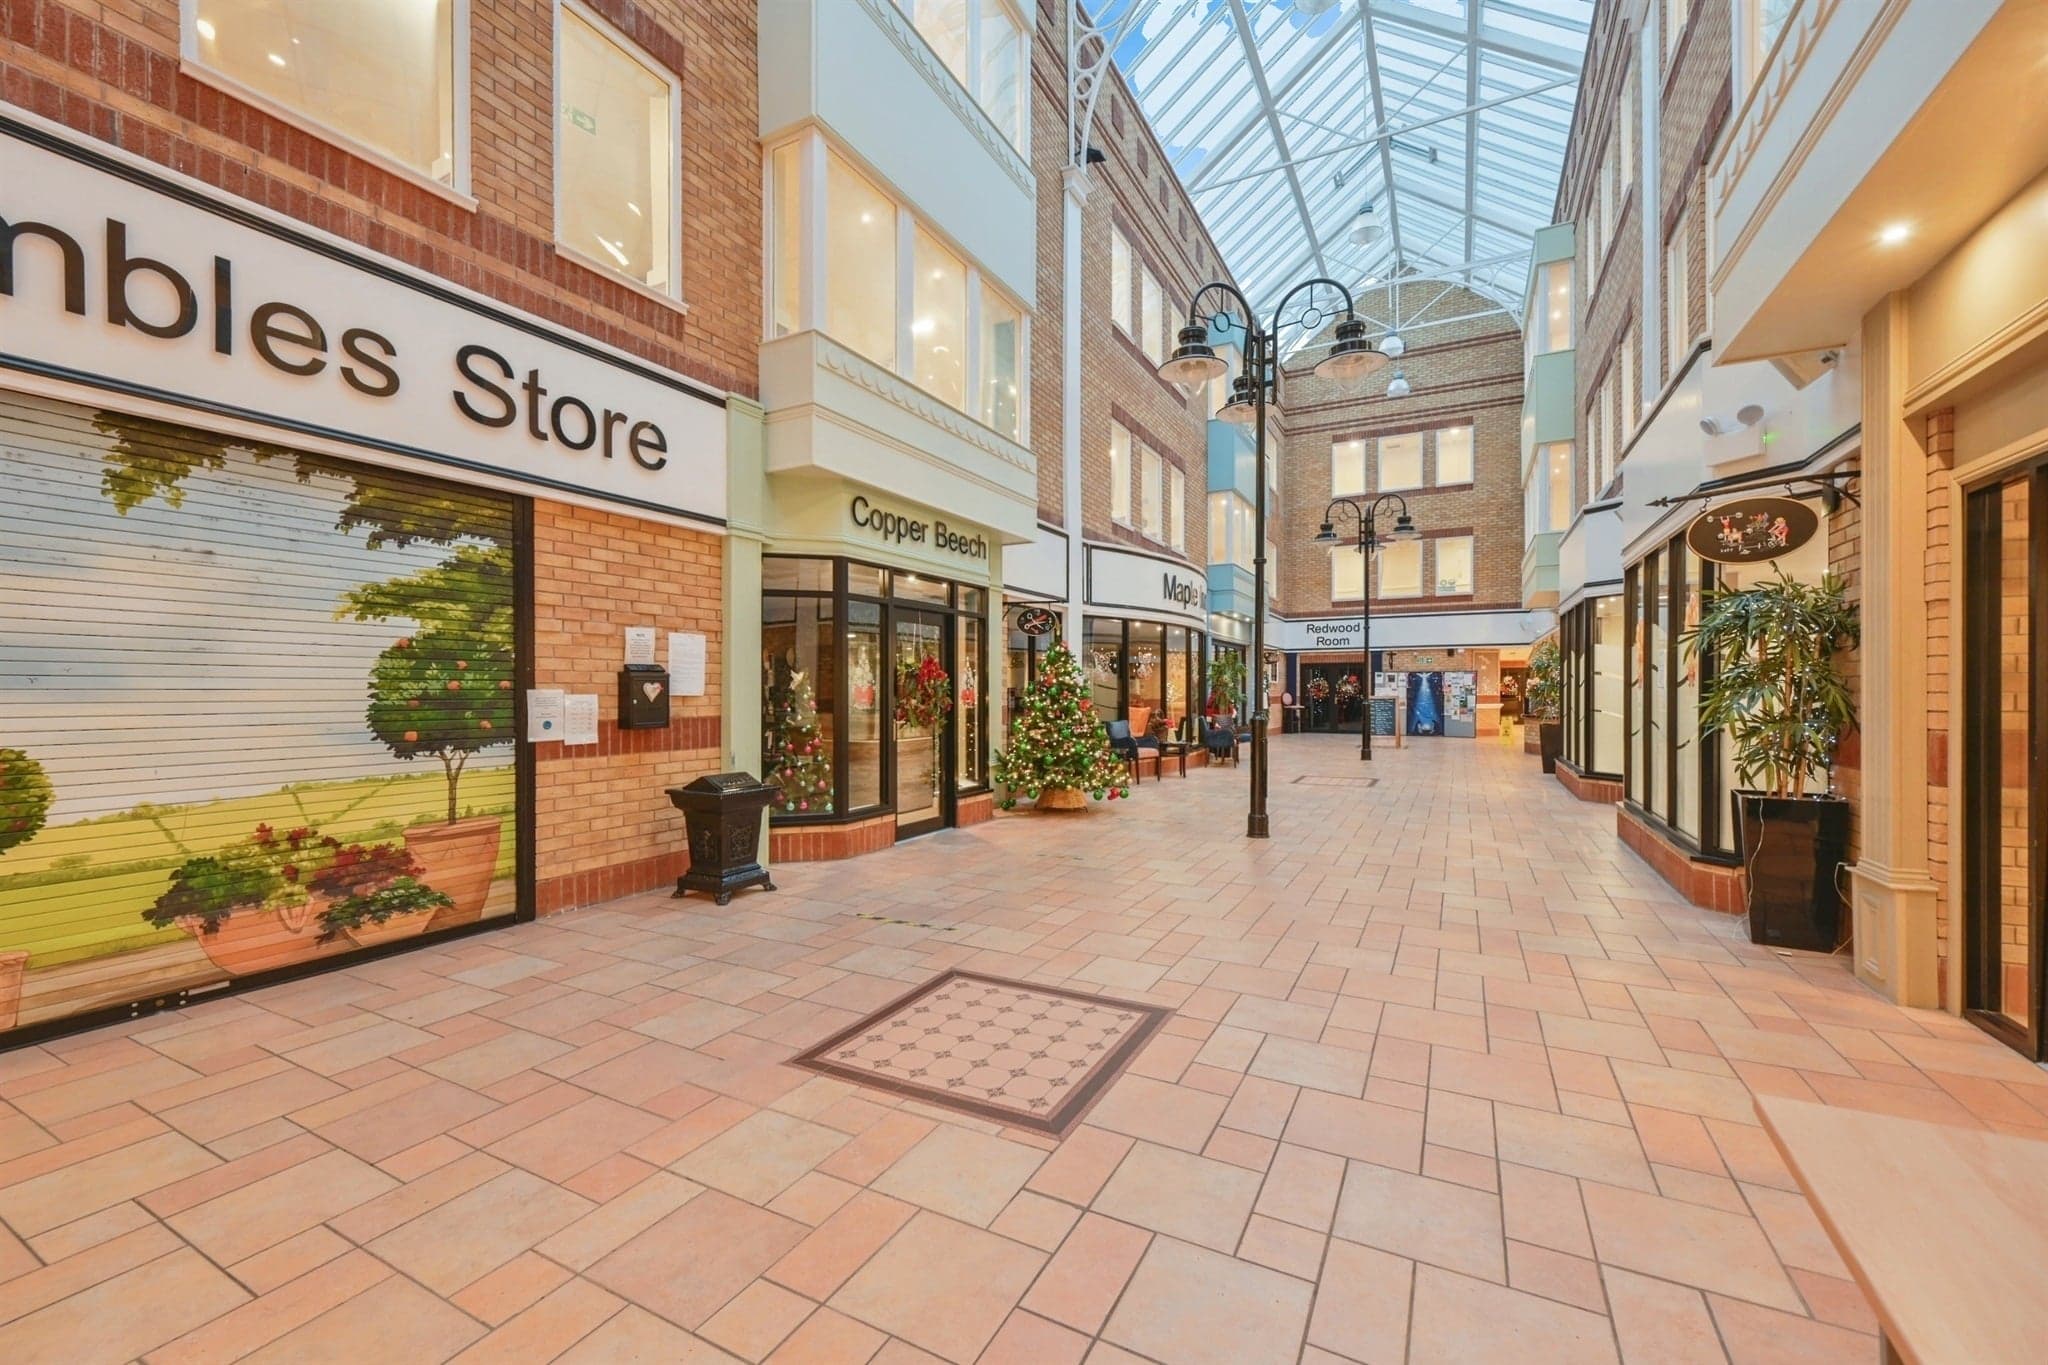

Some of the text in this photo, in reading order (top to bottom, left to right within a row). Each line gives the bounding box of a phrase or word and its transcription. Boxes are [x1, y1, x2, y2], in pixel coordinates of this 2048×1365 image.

[452, 344, 668, 471] Store
[852, 495, 987, 560] Copper Beech
[1163, 572, 1198, 610] Maple
[1306, 622, 1361, 635] Redwood
[1316, 636, 1350, 648] Room
